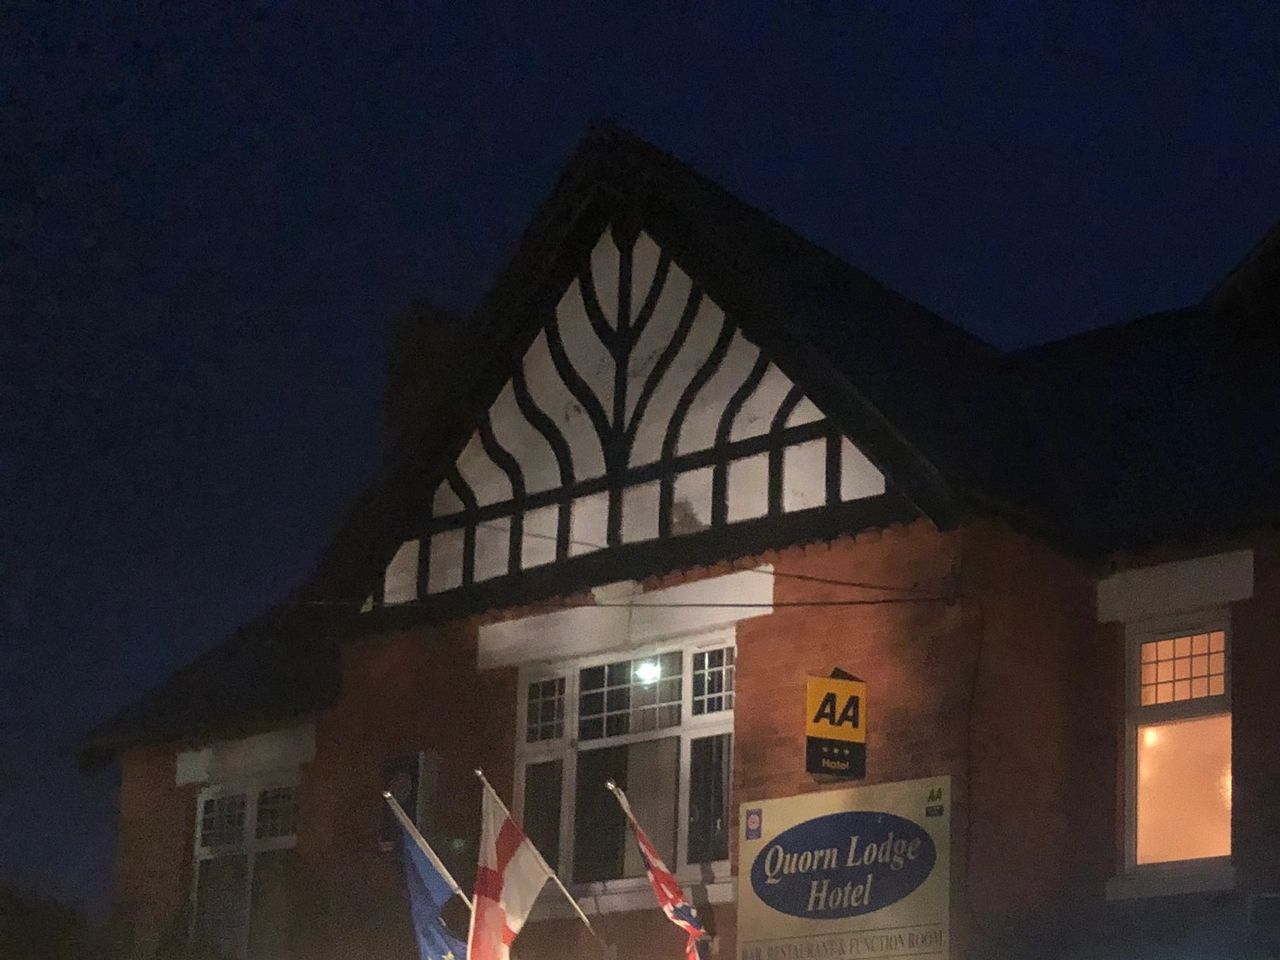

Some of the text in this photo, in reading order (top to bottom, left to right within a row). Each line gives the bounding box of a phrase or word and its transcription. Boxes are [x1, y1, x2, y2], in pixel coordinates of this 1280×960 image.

[812, 692, 860, 729] AA
[822, 758, 850, 770] Hotel
[763, 831, 922, 886] Quorn Lodge
[806, 872, 874, 913] Hotel
[848, 932, 905, 955] FUNCTION
[907, 929, 943, 949] ROOM
